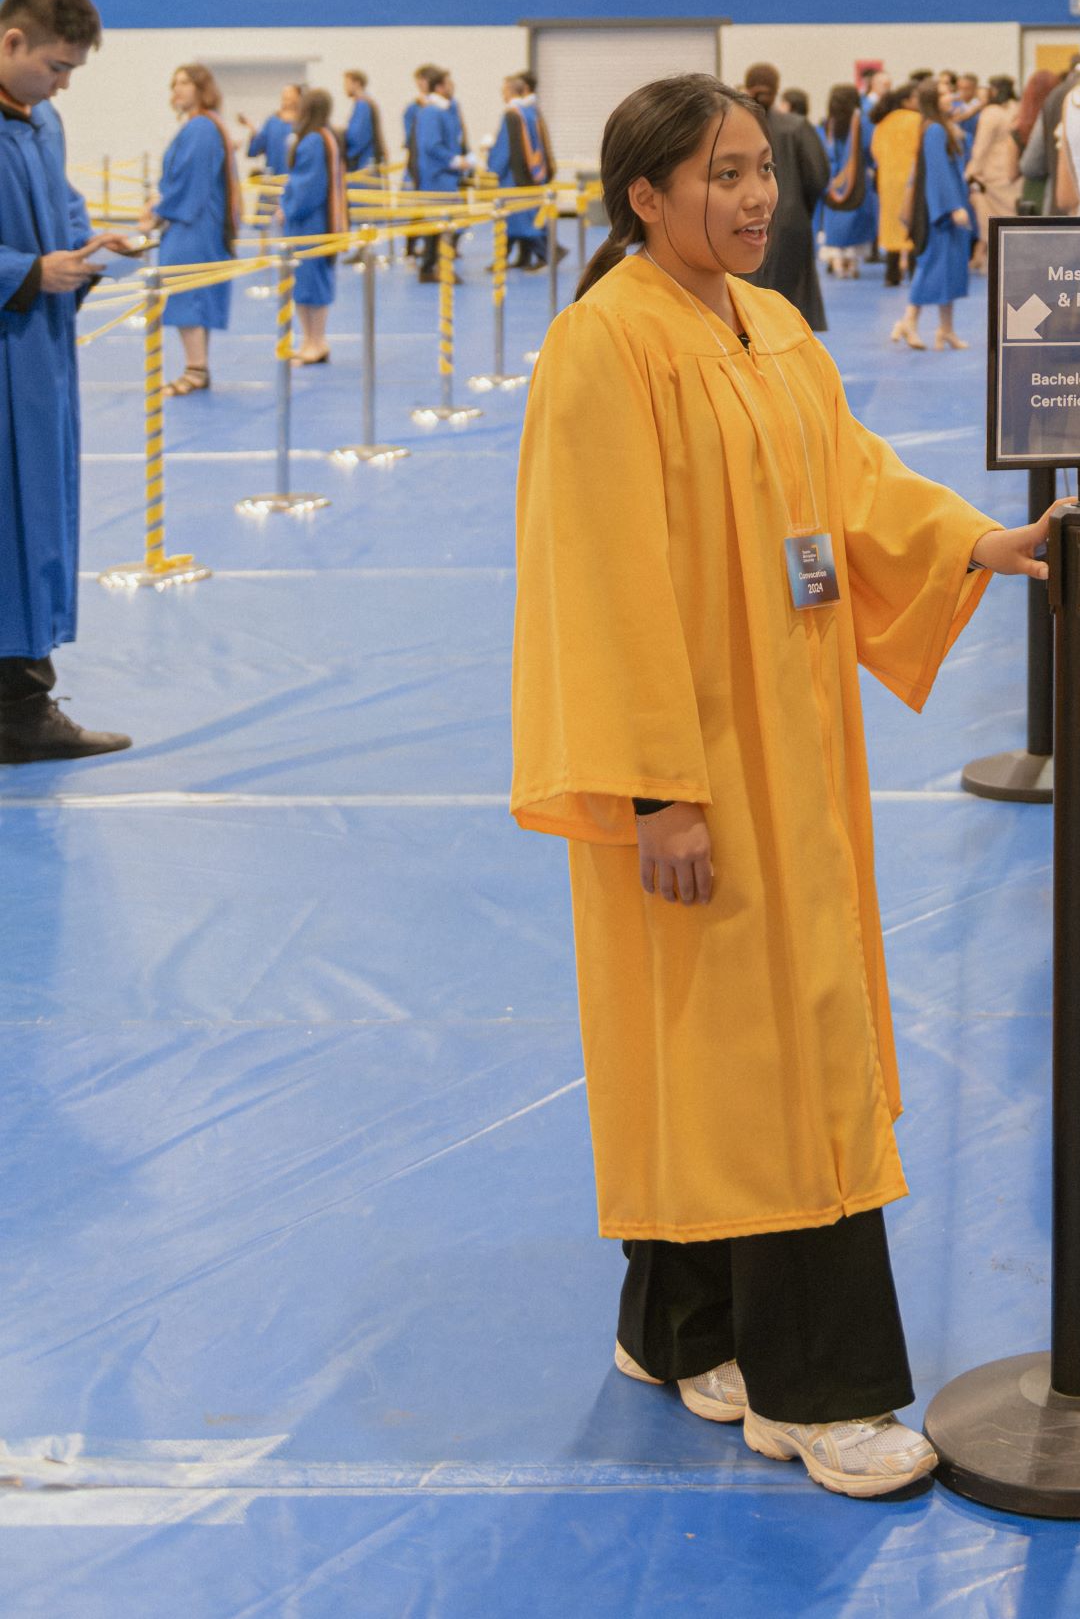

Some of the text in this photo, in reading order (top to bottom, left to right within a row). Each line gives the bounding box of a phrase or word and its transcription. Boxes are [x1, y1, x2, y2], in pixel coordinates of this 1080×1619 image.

[1058, 292, 1071, 308] &
[799, 569, 827, 580] Convocation
[807, 582, 824, 594] 2024
